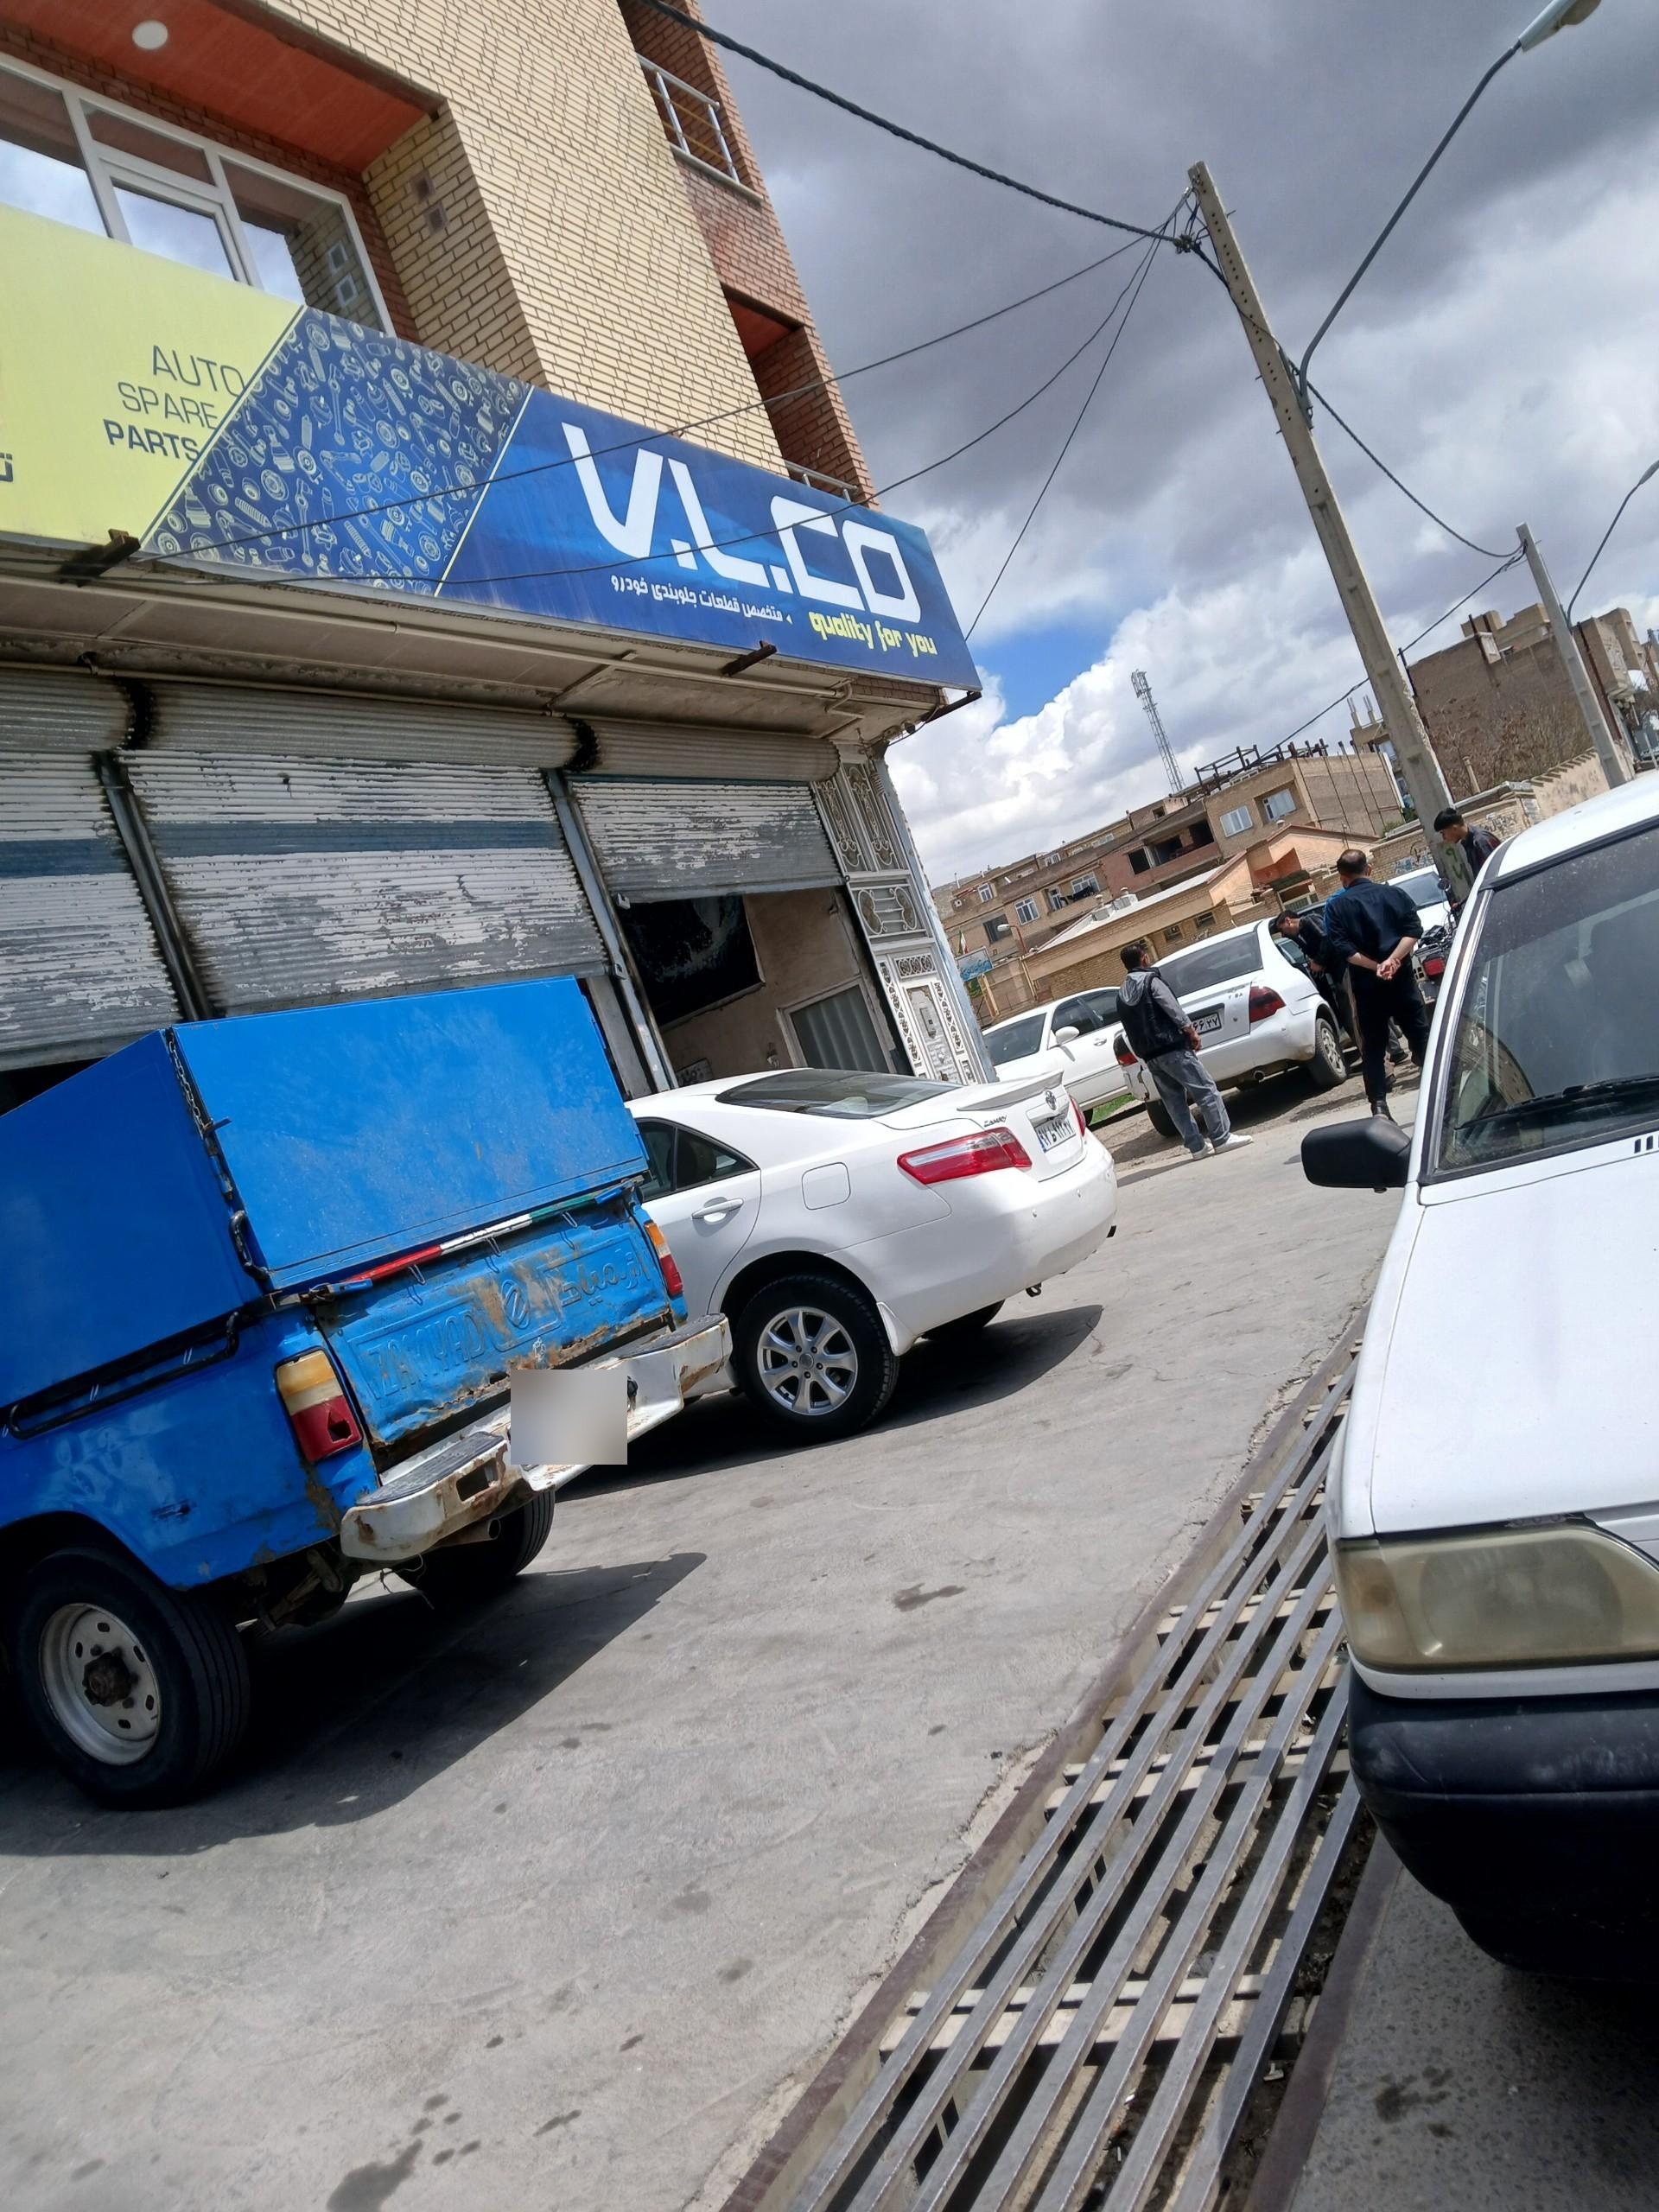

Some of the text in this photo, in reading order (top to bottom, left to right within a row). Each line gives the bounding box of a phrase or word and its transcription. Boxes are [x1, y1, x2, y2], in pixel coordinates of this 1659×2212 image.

[152, 345, 245, 397] AUTO
[118, 381, 218, 430] SPARE
[103, 418, 201, 462] PARTS
[610, 574, 784, 622] متخصص قطعات جلوبندی خودرو
[808, 611, 938, 657] quality for you
